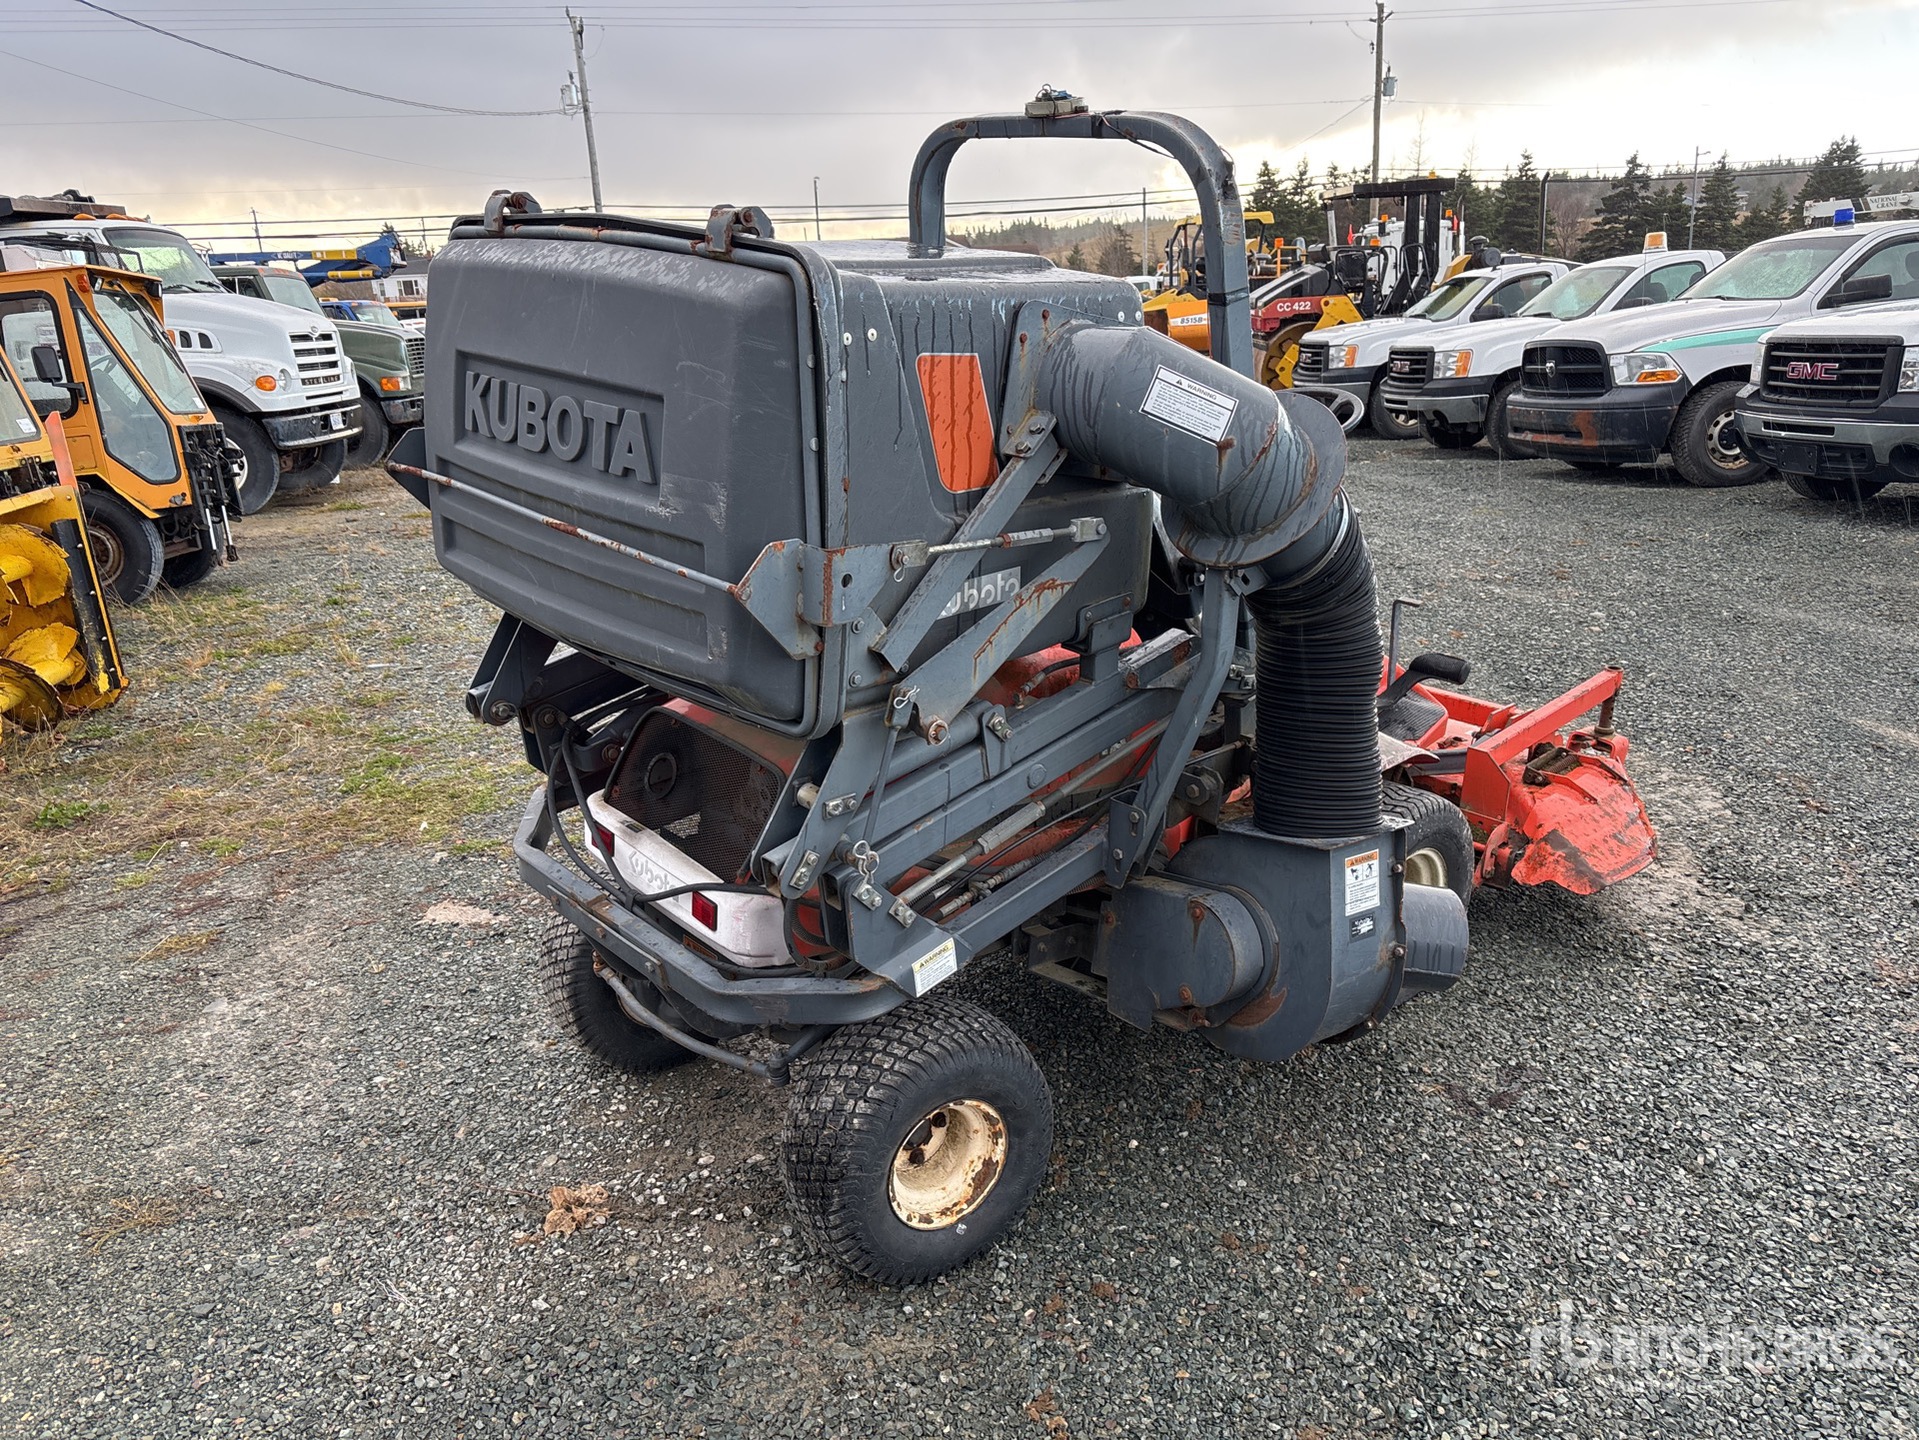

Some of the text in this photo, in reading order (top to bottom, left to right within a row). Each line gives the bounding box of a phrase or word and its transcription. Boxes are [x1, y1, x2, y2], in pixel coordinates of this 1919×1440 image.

[1870, 196, 1898, 204] NATIONAL
[1277, 302, 1311, 312] CC 422
[1787, 362, 1839, 380] GMC
[1186, 383, 1217, 400] WARNING
[465, 371, 657, 484] KUBOTA
